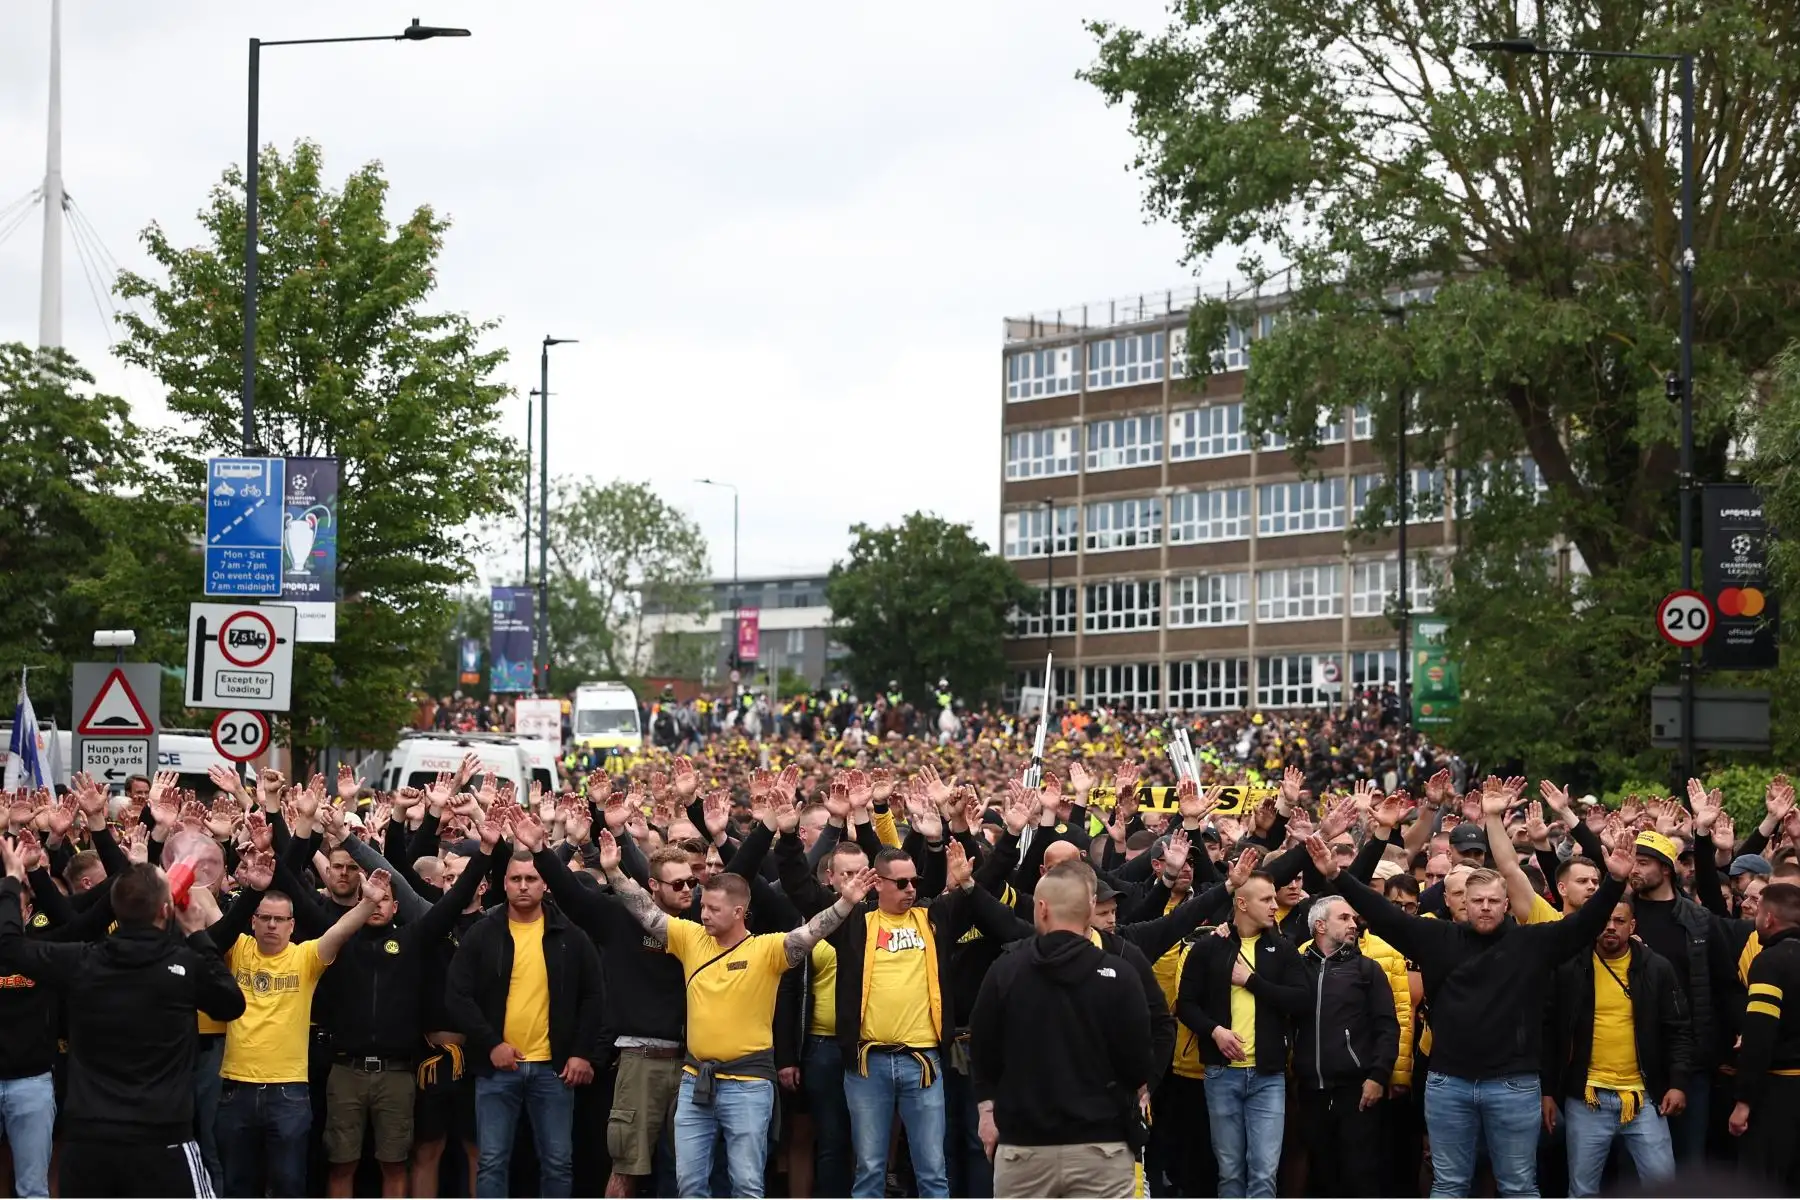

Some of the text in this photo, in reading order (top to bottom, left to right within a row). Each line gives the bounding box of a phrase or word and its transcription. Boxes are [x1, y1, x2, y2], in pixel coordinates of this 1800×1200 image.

[214, 499, 230, 507] taxi
[223, 550, 243, 559] Mon
[249, 550, 265, 559] Sat
[212, 571, 275, 582] On event days
[237, 581, 276, 592] midnight
[1667, 608, 1706, 630] 20
[221, 675, 268, 685] Except for
[227, 684, 261, 695] loading
[221, 722, 260, 745] 20
[87, 744, 143, 754] Humps for
[87, 755, 143, 766] 530 yards
[421, 759, 452, 768] POLICE
